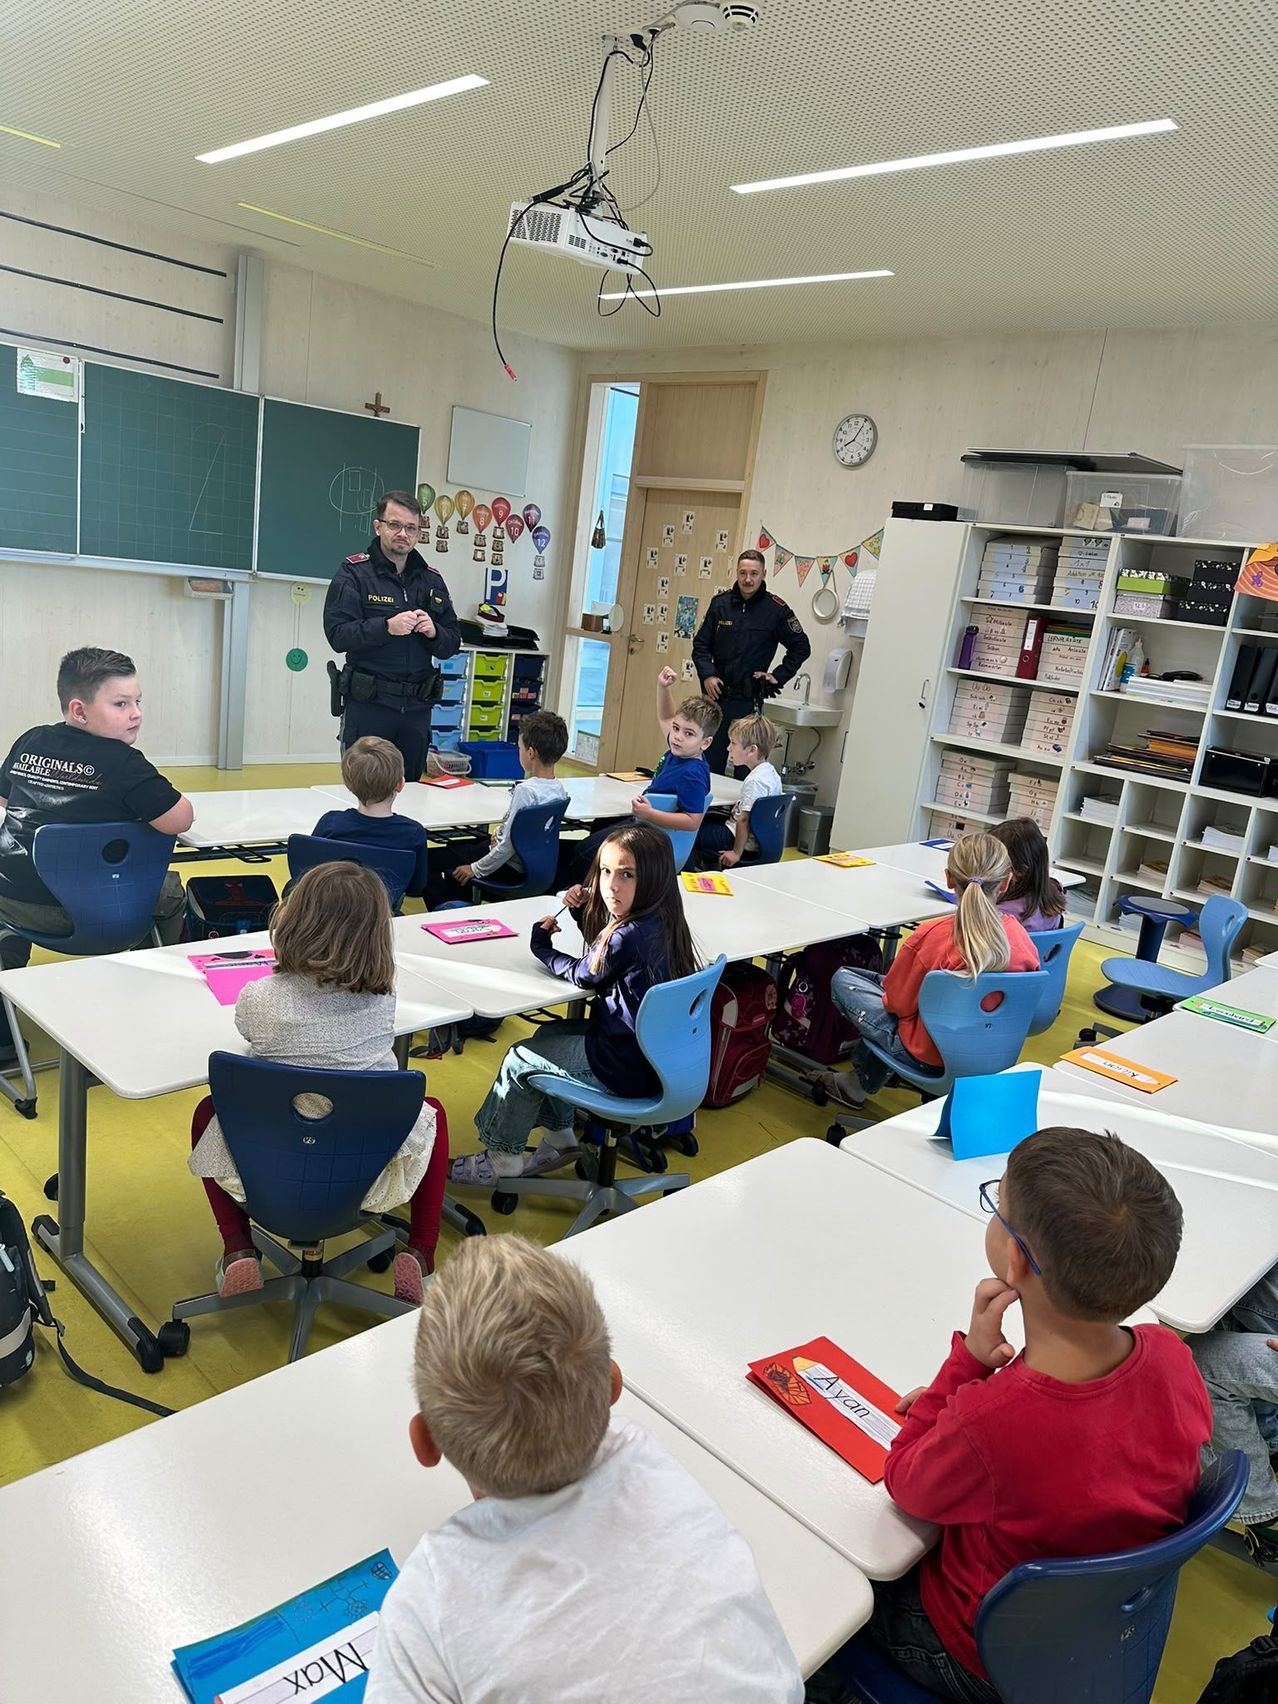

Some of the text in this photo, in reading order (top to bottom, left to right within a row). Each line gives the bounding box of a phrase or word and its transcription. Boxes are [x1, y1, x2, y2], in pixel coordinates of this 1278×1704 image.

[499, 510, 504, 518] 9
[511, 527, 520, 536] 10
[537, 538, 546, 547] 12
[368, 594, 394, 603] POLIZEI
[813, 1376, 870, 1418] Ayan
[283, 1642, 368, 1695] Max
